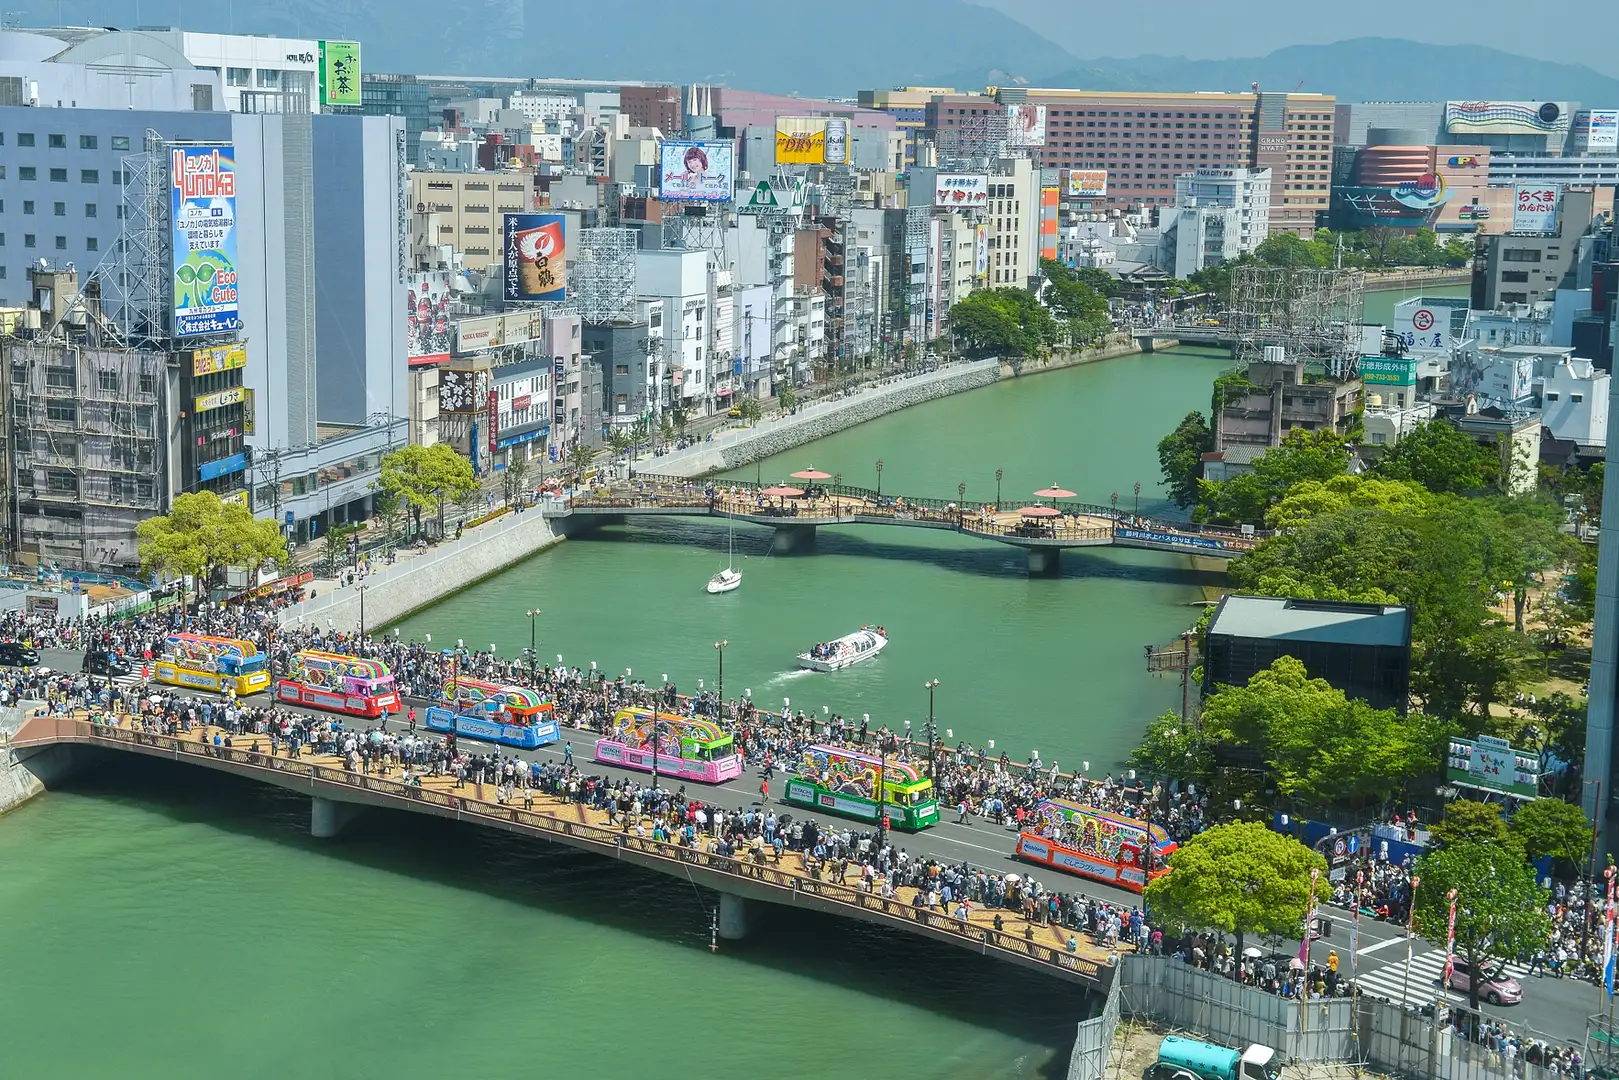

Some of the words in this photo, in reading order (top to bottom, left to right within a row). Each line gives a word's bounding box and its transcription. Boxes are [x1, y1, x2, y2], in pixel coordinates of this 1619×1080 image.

[188, 158, 212, 170] ユノカ
[1518, 190, 1554, 202] ちくま
[738, 206, 788, 214] ウチヤマグループ
[1518, 204, 1554, 212] めんたい
[217, 270, 236, 284] Eco
[212, 286, 236, 302] Cute
[186, 318, 238, 334] 株式会社キューヘン
[792, 786, 812, 794] HITACHI
[1064, 857, 1106, 874] にしてつグループ
